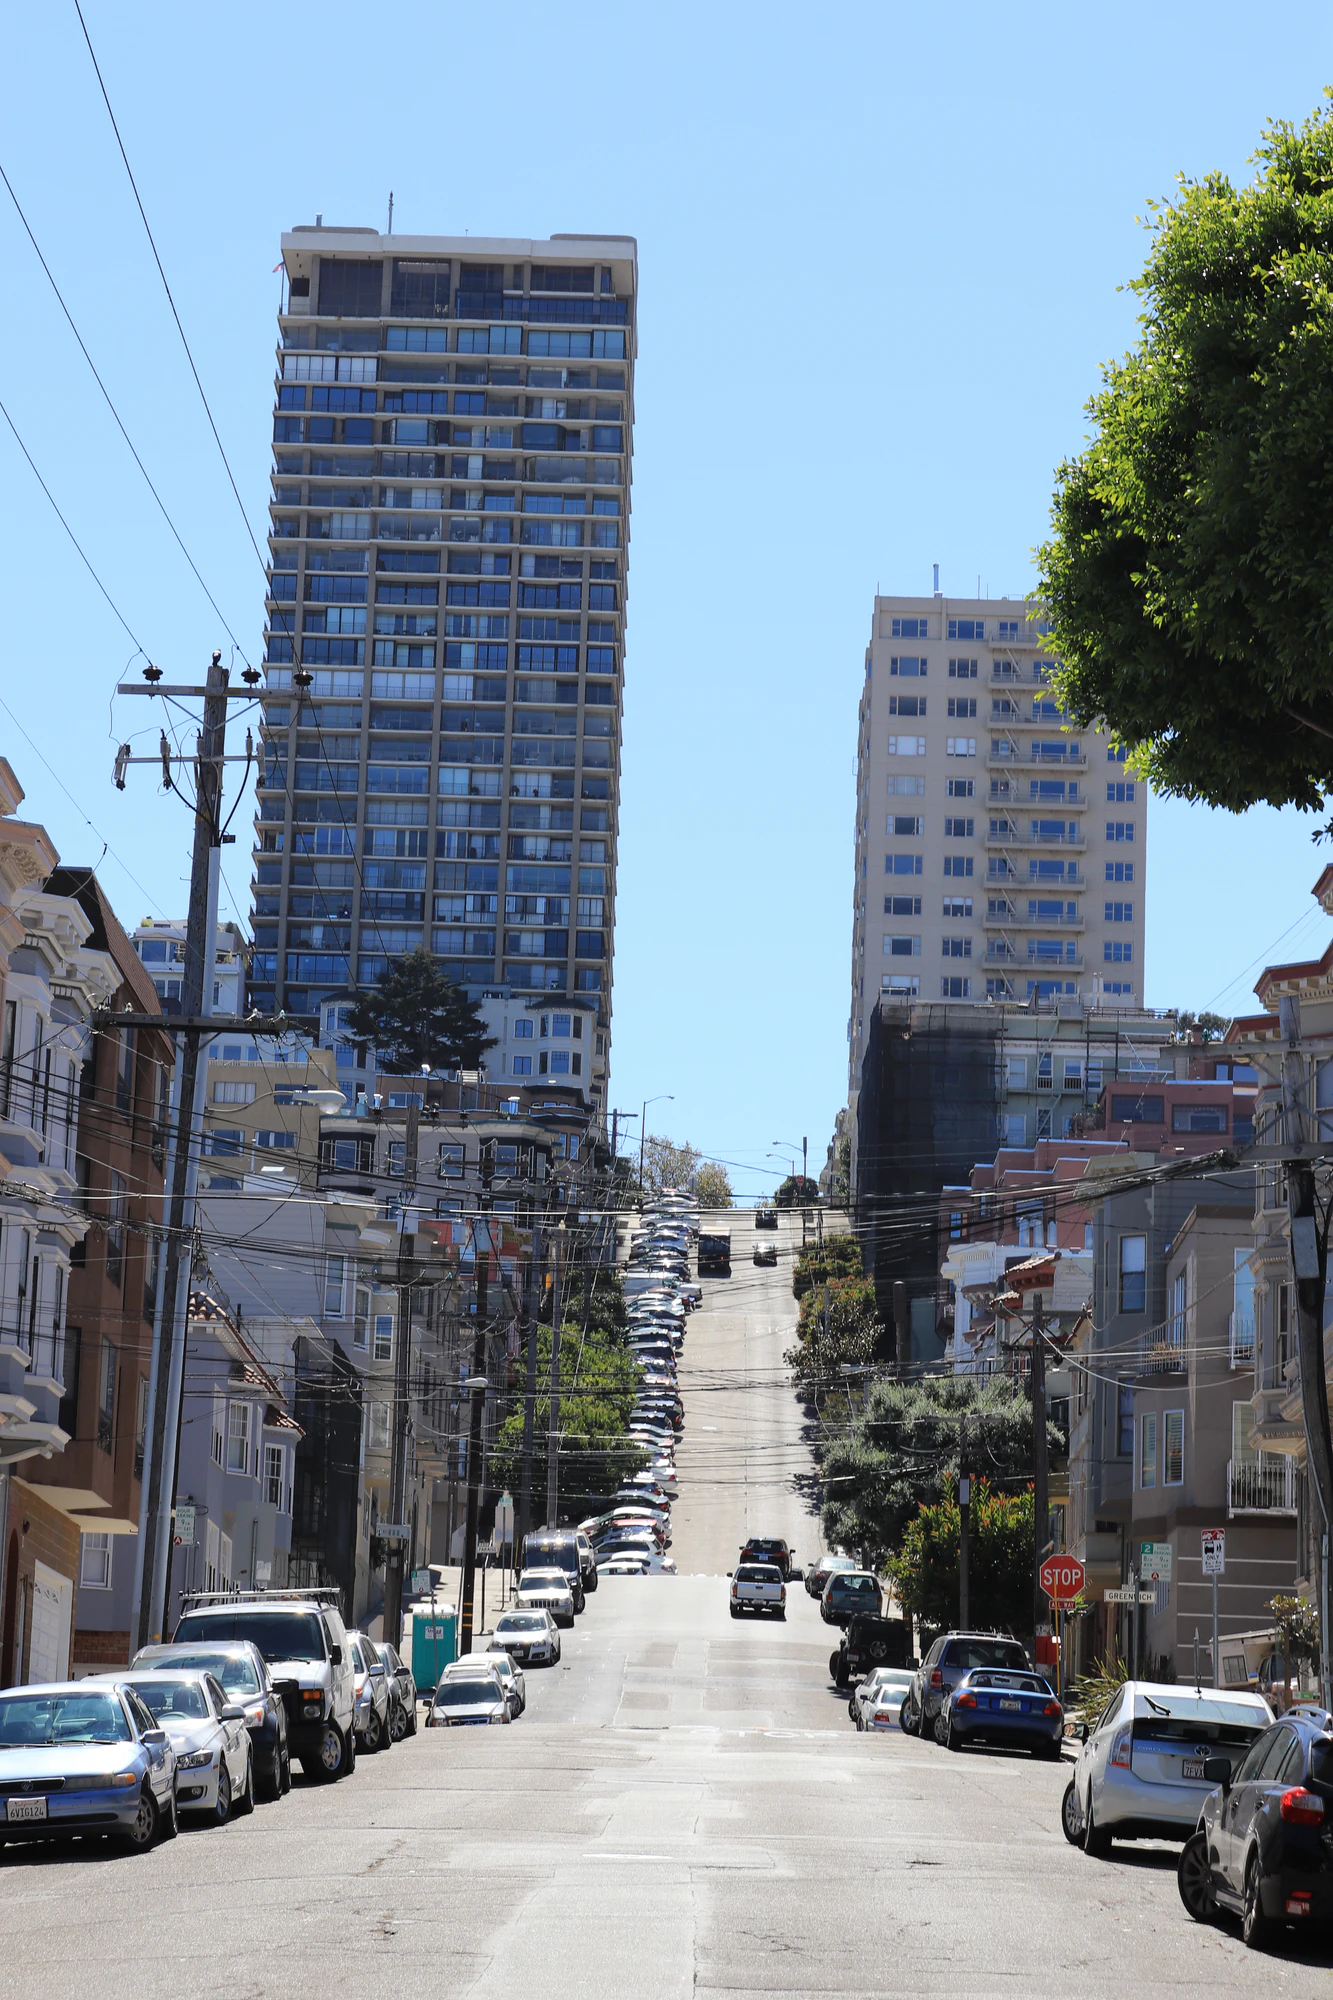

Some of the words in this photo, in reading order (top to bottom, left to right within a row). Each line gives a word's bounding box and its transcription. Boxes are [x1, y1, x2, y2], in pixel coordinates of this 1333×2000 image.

[1144, 1544, 1151, 1553] 2
[1043, 1568, 1082, 1586] STOP
[1108, 1592, 1152, 1601] GREENICH
[10, 1807, 44, 1818] 6VIG124
